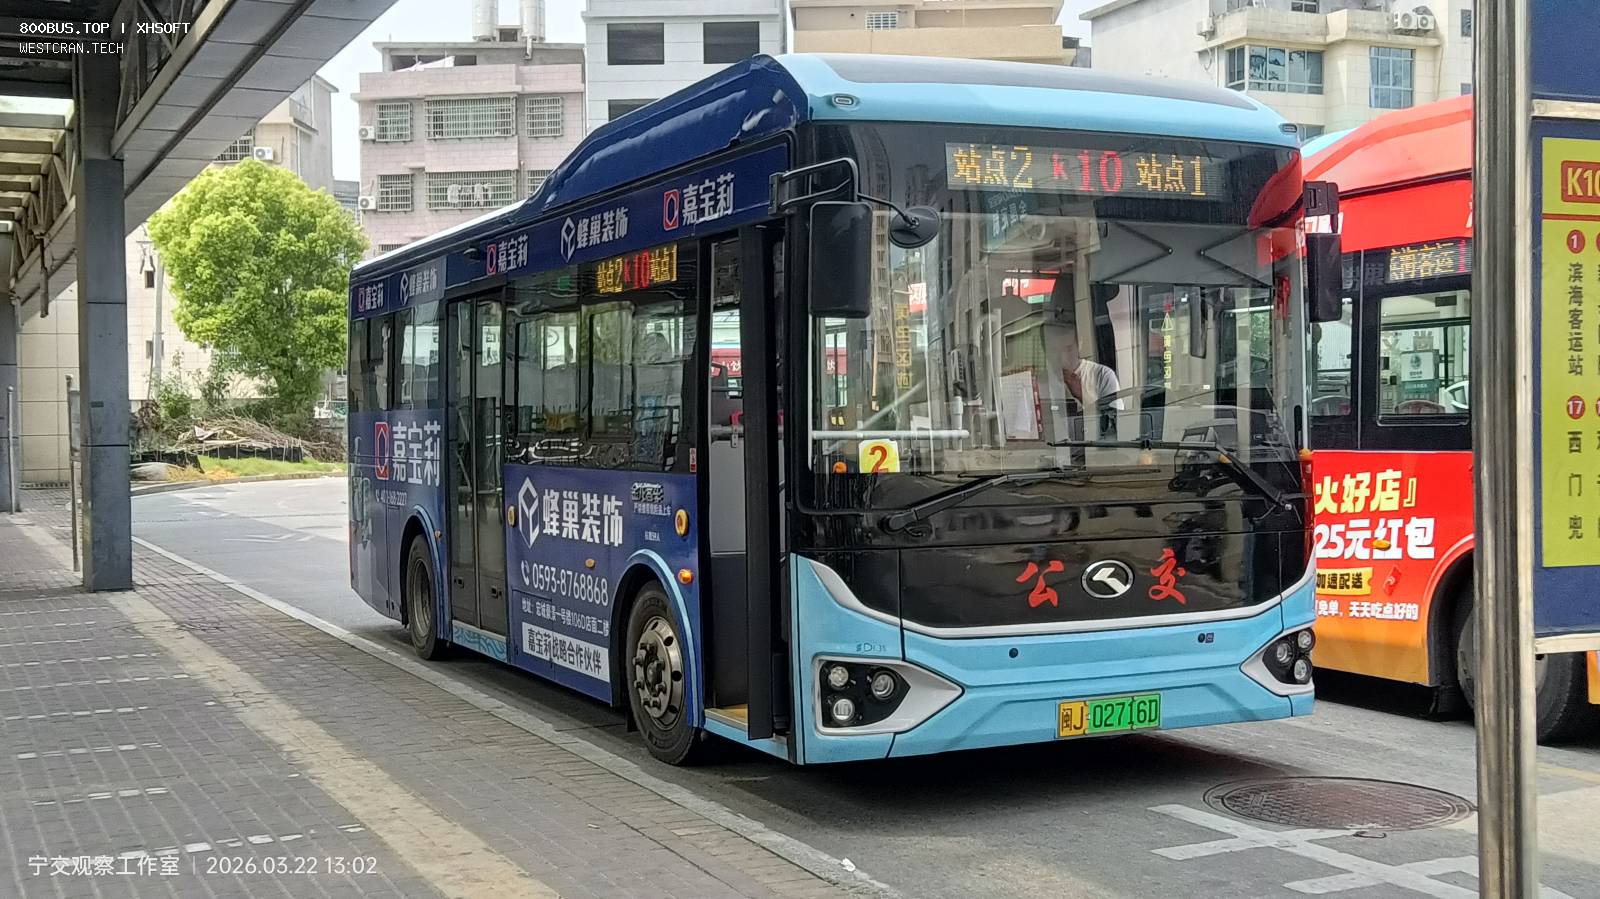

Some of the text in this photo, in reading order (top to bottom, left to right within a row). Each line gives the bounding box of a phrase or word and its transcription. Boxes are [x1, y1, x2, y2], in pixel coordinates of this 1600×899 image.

[953, 145, 1033, 188] 站点2
[1136, 153, 1206, 196] 站点1
[682, 172, 734, 226] 嘉宝莉
[576, 207, 629, 249] 蜂巢装饰
[1570, 234, 1579, 249] 1
[498, 235, 528, 273] 嘉宝莉
[365, 283, 384, 309] 嘉宝莉
[1568, 262, 1583, 376] 滨海客运站
[1567, 400, 1583, 415] 17
[392, 421, 440, 486] 嘉宝莉
[869, 445, 888, 474] 2
[542, 489, 624, 547] 蜂巢装饰
[1315, 517, 1435, 560] 25元红包
[532, 563, 609, 606] 0593-8768868
[1016, 547, 1186, 608] 公 交
[1316, 572, 1363, 589] 加速配送
[1315, 599, 1419, 620] 免单，天天吃点好的
[527, 628, 602, 675] 嘉宝莉战略合作伙伴
